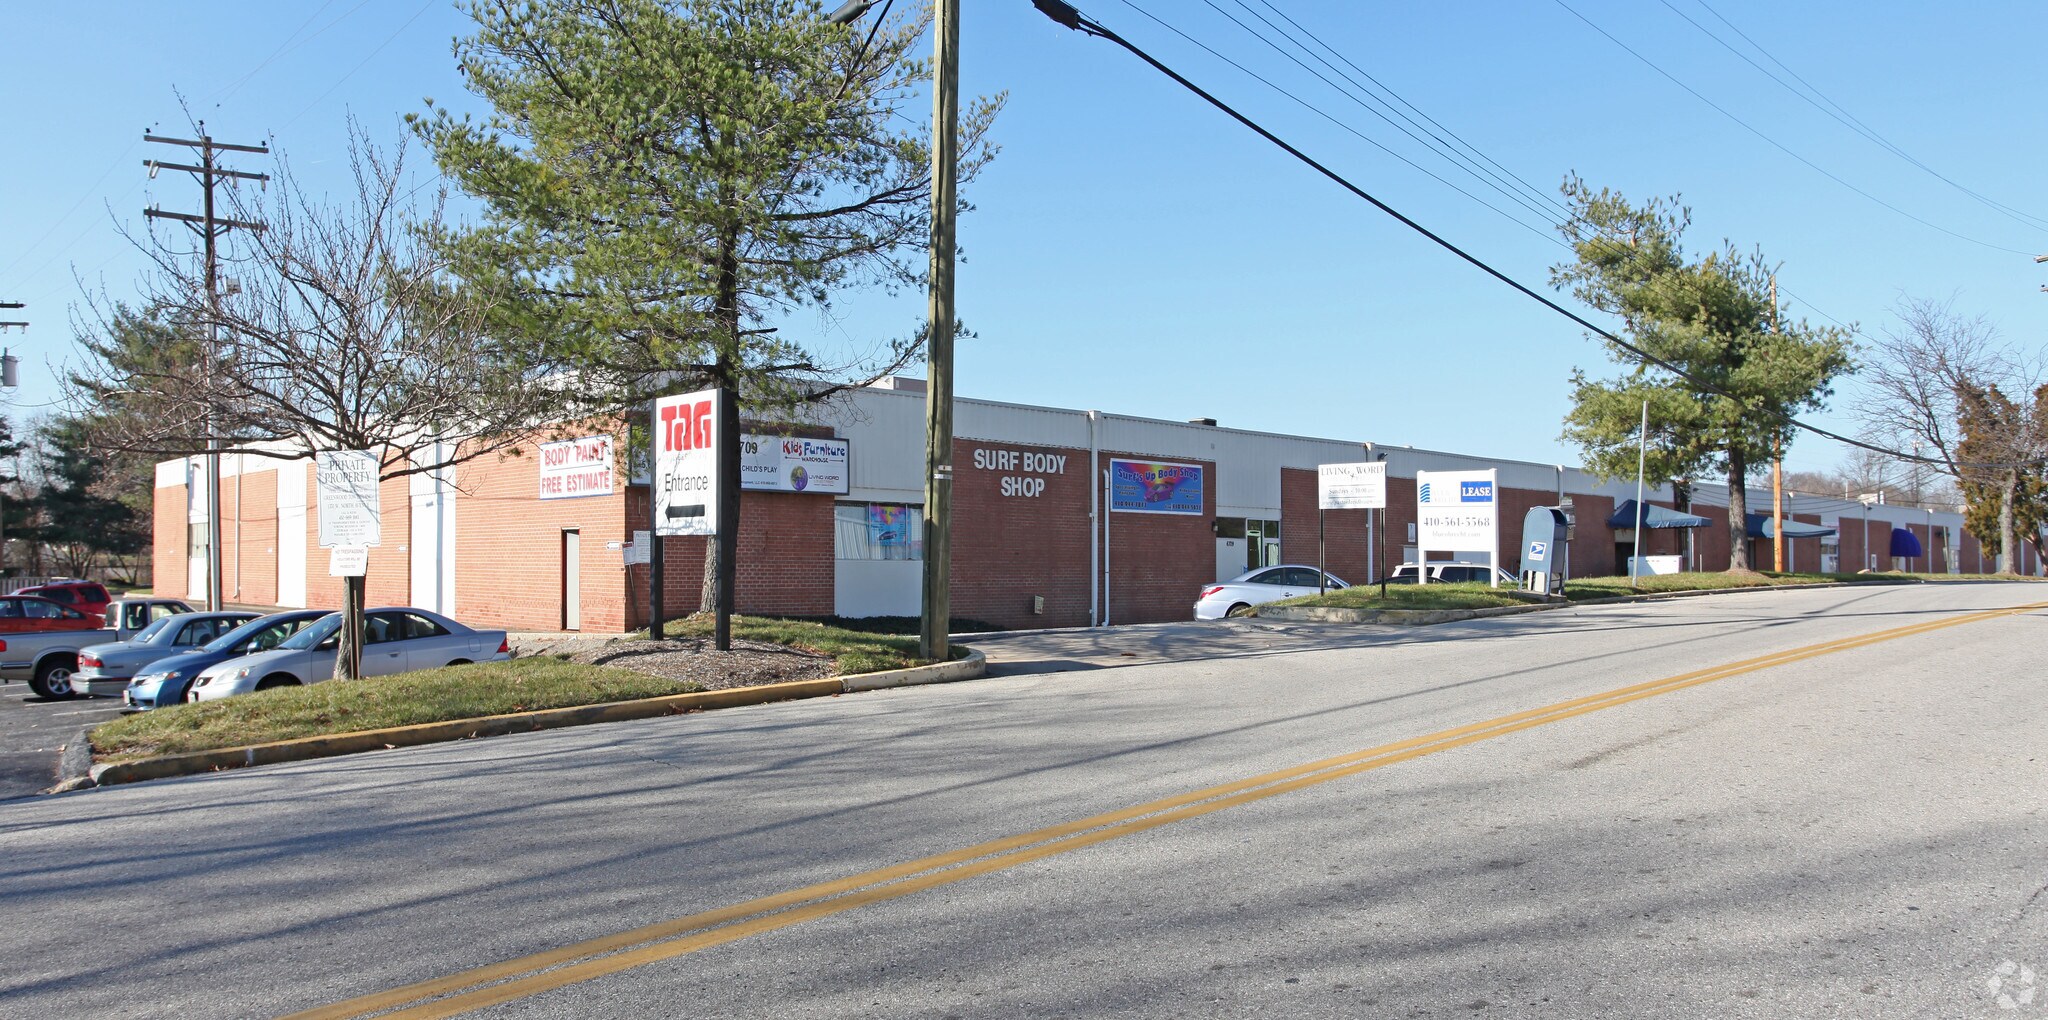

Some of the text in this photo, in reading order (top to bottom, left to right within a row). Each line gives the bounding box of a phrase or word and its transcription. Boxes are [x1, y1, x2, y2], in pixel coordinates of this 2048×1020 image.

[545, 441, 605, 466] BODY PAINT
[782, 440, 845, 457] Kids Furniture
[329, 459, 367, 471] PRIVATE
[742, 465, 762, 473] CHILD'S
[974, 448, 1067, 475] SURF BODY
[324, 471, 371, 485] PROPERTY
[1117, 466, 1199, 482] Surf's Up Body Shop
[1321, 465, 1384, 476] LIVING WORD
[541, 471, 609, 494] FREE ESTIMATE
[665, 472, 708, 492] Entrance
[1001, 476, 1045, 498] SHOP
[1461, 486, 1492, 497] LEASE
[1423, 517, 1490, 527] 410-561-5568
